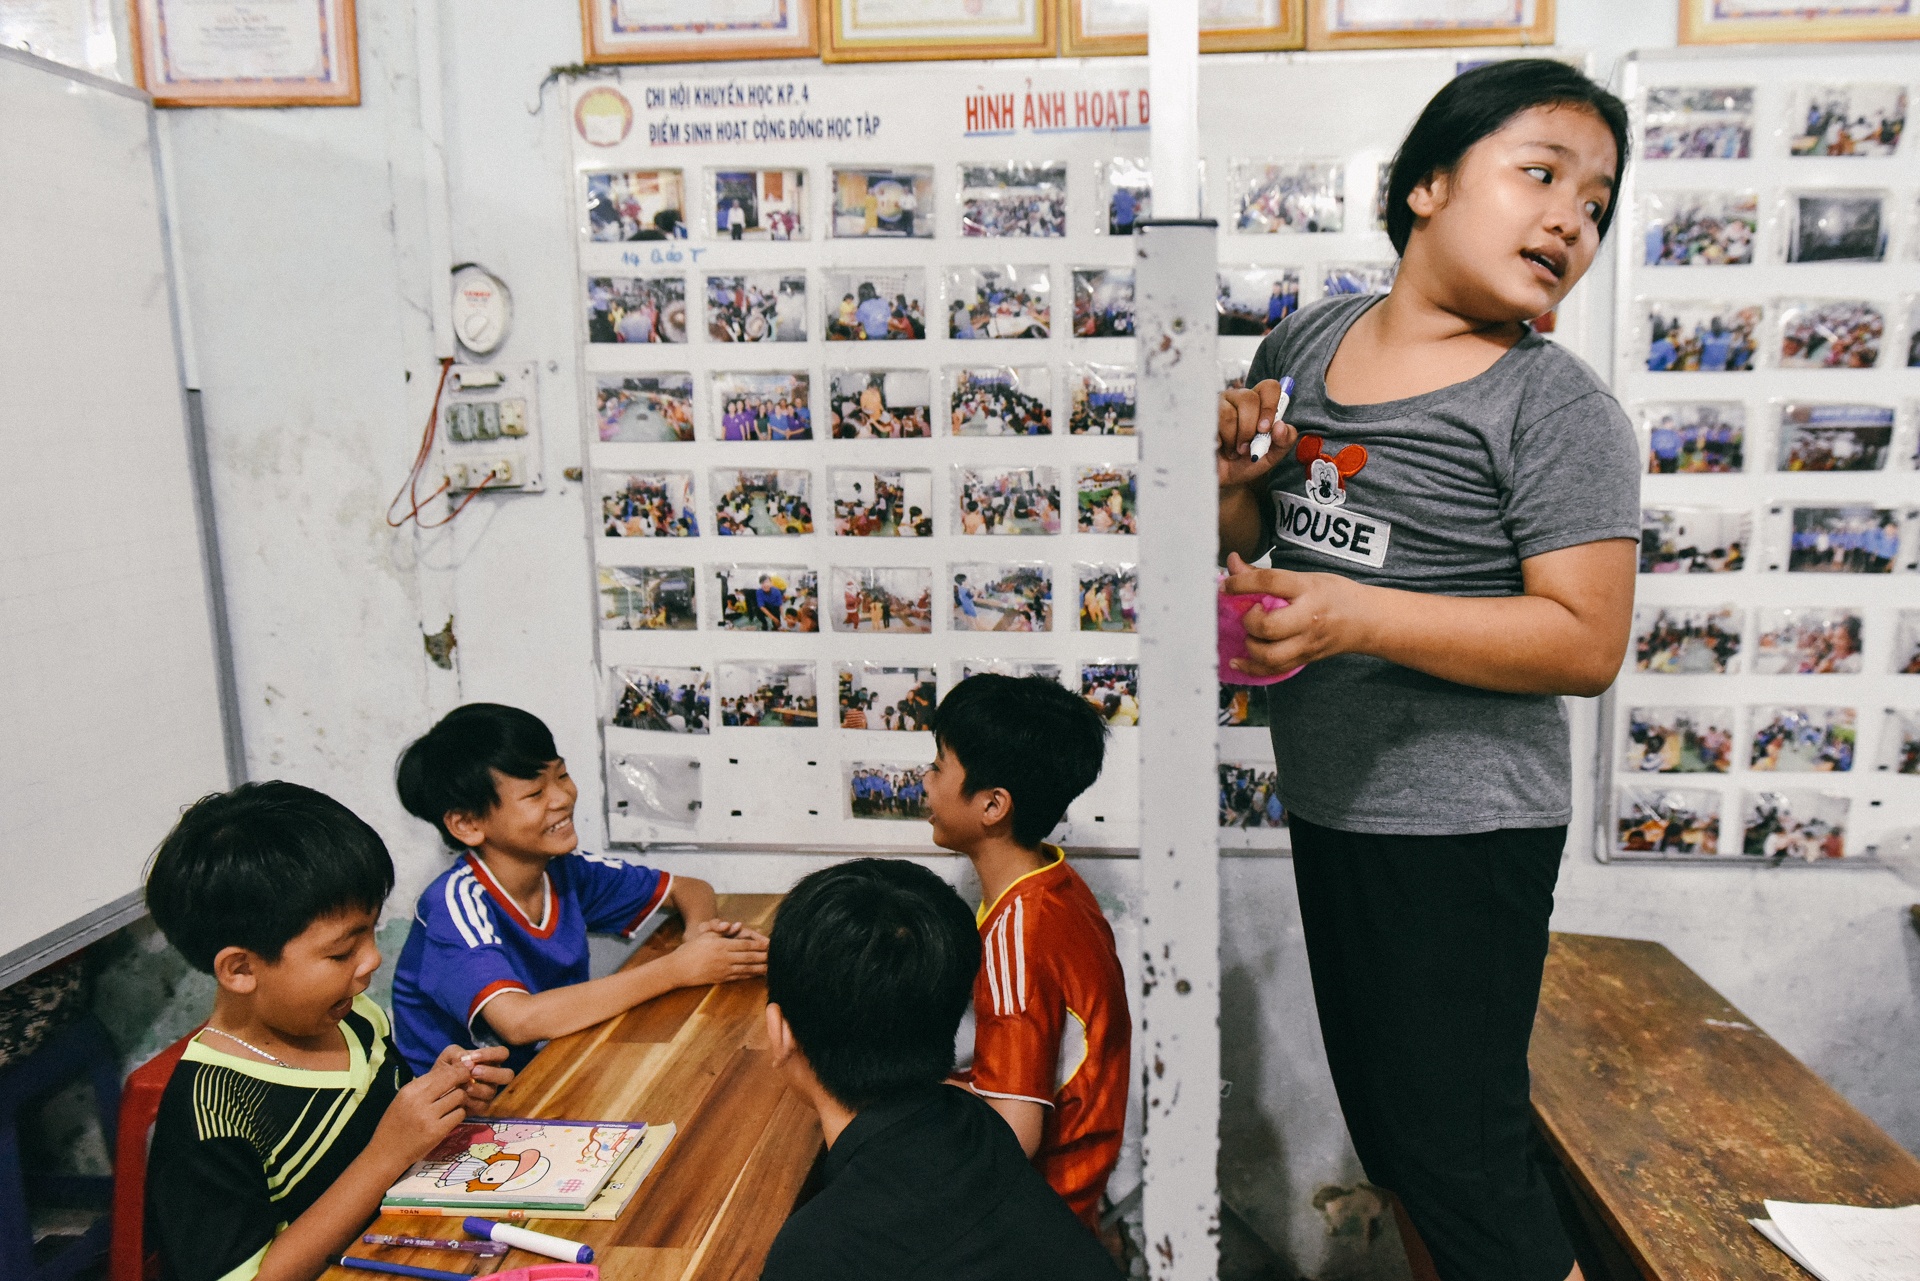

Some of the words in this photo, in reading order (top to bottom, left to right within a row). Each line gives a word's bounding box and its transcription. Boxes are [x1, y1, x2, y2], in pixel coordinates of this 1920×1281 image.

[646, 86, 665, 107] CHI
[669, 82, 691, 109] HỘI
[694, 78, 744, 106] KHUYẾN
[748, 84, 773, 108] HỌC
[966, 84, 1014, 131] HÌNH
[1023, 77, 1066, 128] ẢNH
[684, 122, 712, 143] SINH
[753, 113, 786, 142] CỘNG
[827, 116, 852, 141] HỌC
[1279, 499, 1376, 556] MOUSE
